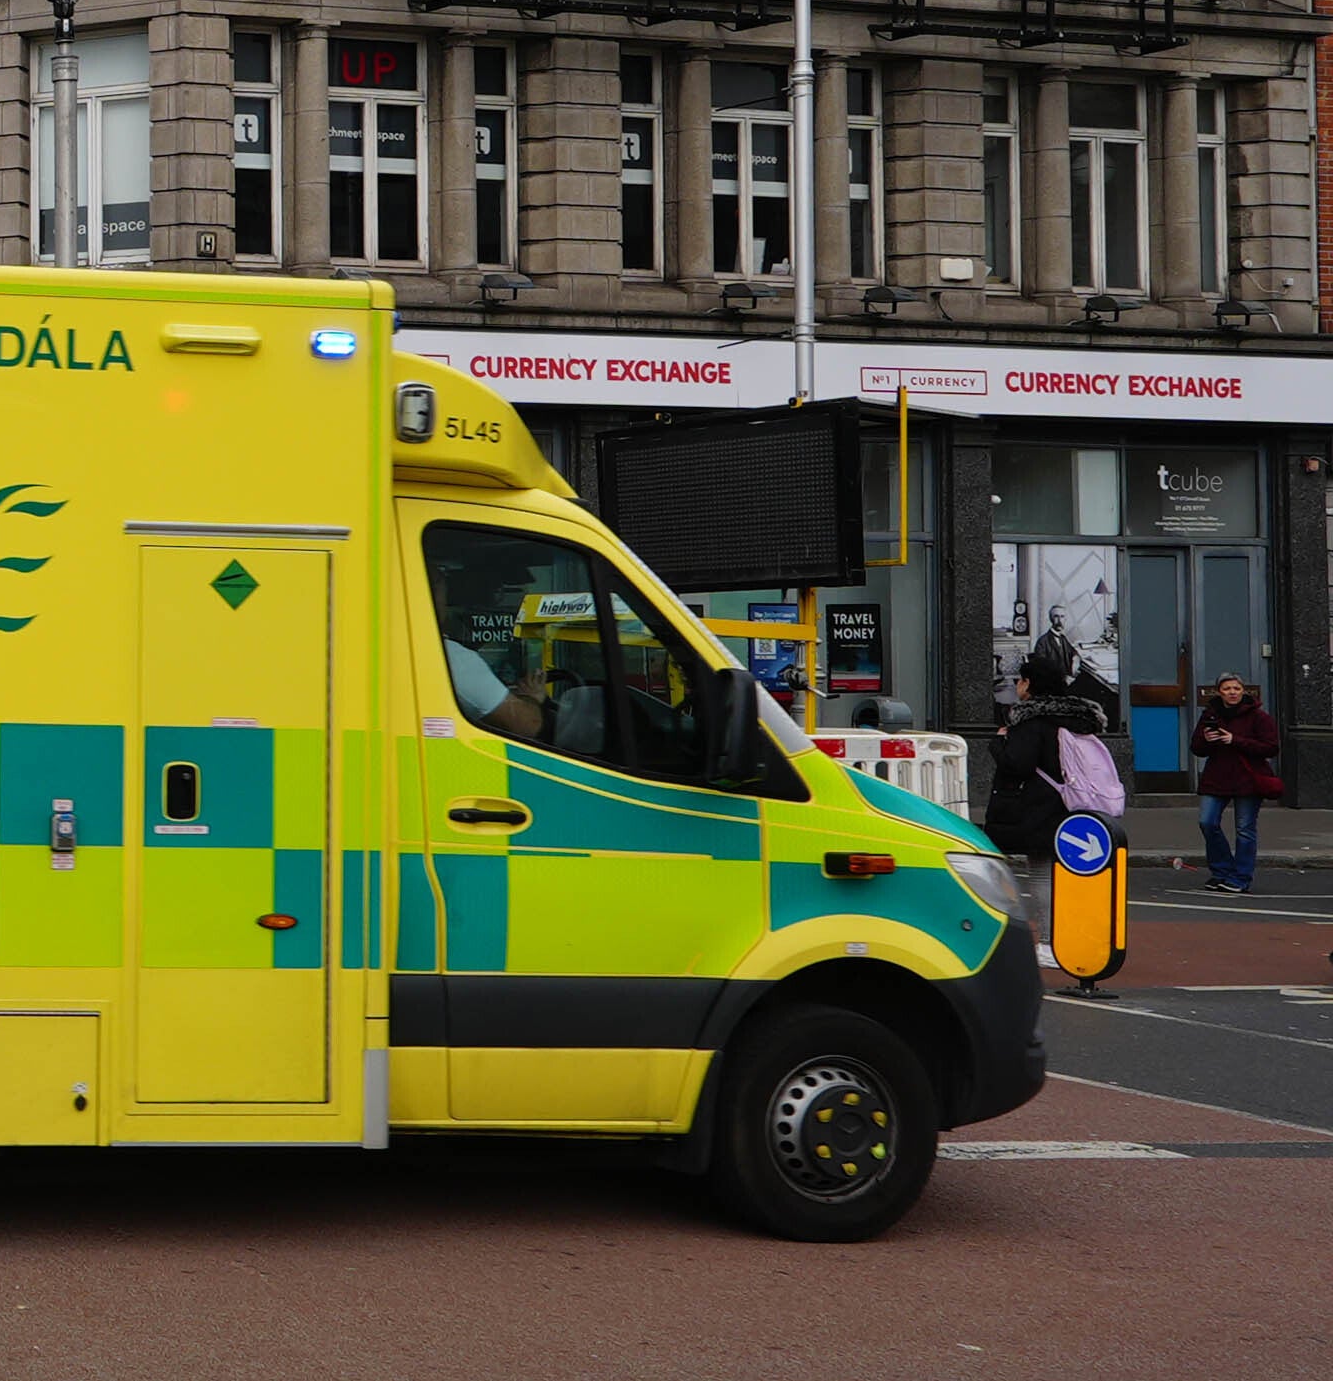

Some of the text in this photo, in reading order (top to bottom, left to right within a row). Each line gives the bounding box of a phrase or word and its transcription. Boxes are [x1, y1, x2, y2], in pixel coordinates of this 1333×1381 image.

[342, 51, 397, 85] UP
[377, 131, 406, 141] space
[102, 220, 146, 236] space
[470, 355, 731, 384] CURRENCY EXCHANGE
[911, 377, 976, 387] CURRENCY
[1005, 371, 1242, 399] CURRENCY EXCHANGE
[444, 418, 501, 443] 5L45
[1157, 465, 1223, 492] tcube
[539, 600, 593, 614] highway
[471, 615, 514, 628] TRAVEL
[833, 613, 875, 625] TRAVEL
[833, 627, 876, 640] MONEY
